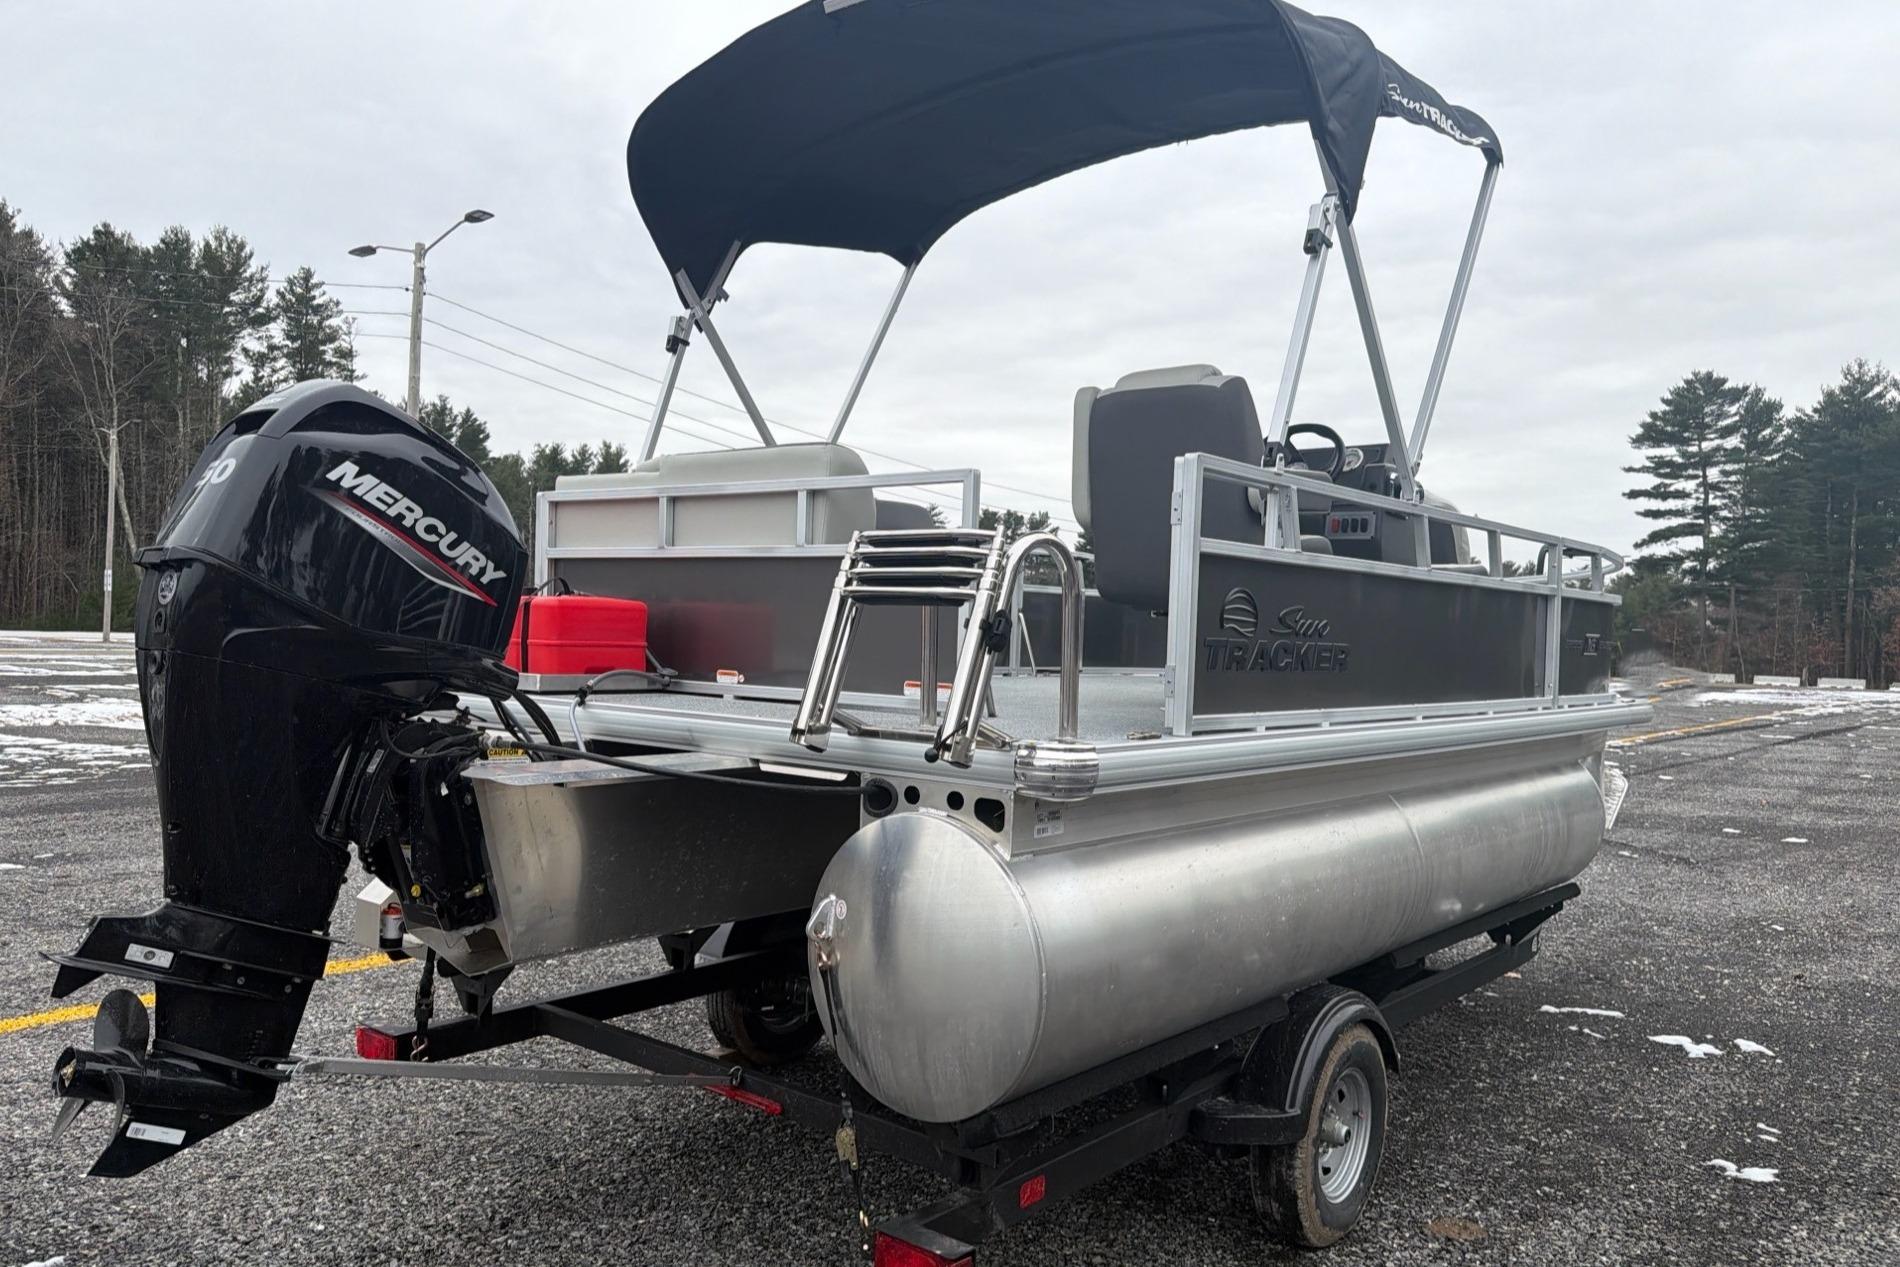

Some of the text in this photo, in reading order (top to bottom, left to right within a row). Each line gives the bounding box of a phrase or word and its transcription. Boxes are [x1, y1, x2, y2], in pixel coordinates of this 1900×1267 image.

[325, 460, 507, 585] MERCURY
[1203, 637, 1350, 673] TRACKER
[488, 748, 518, 756] CAUTION
